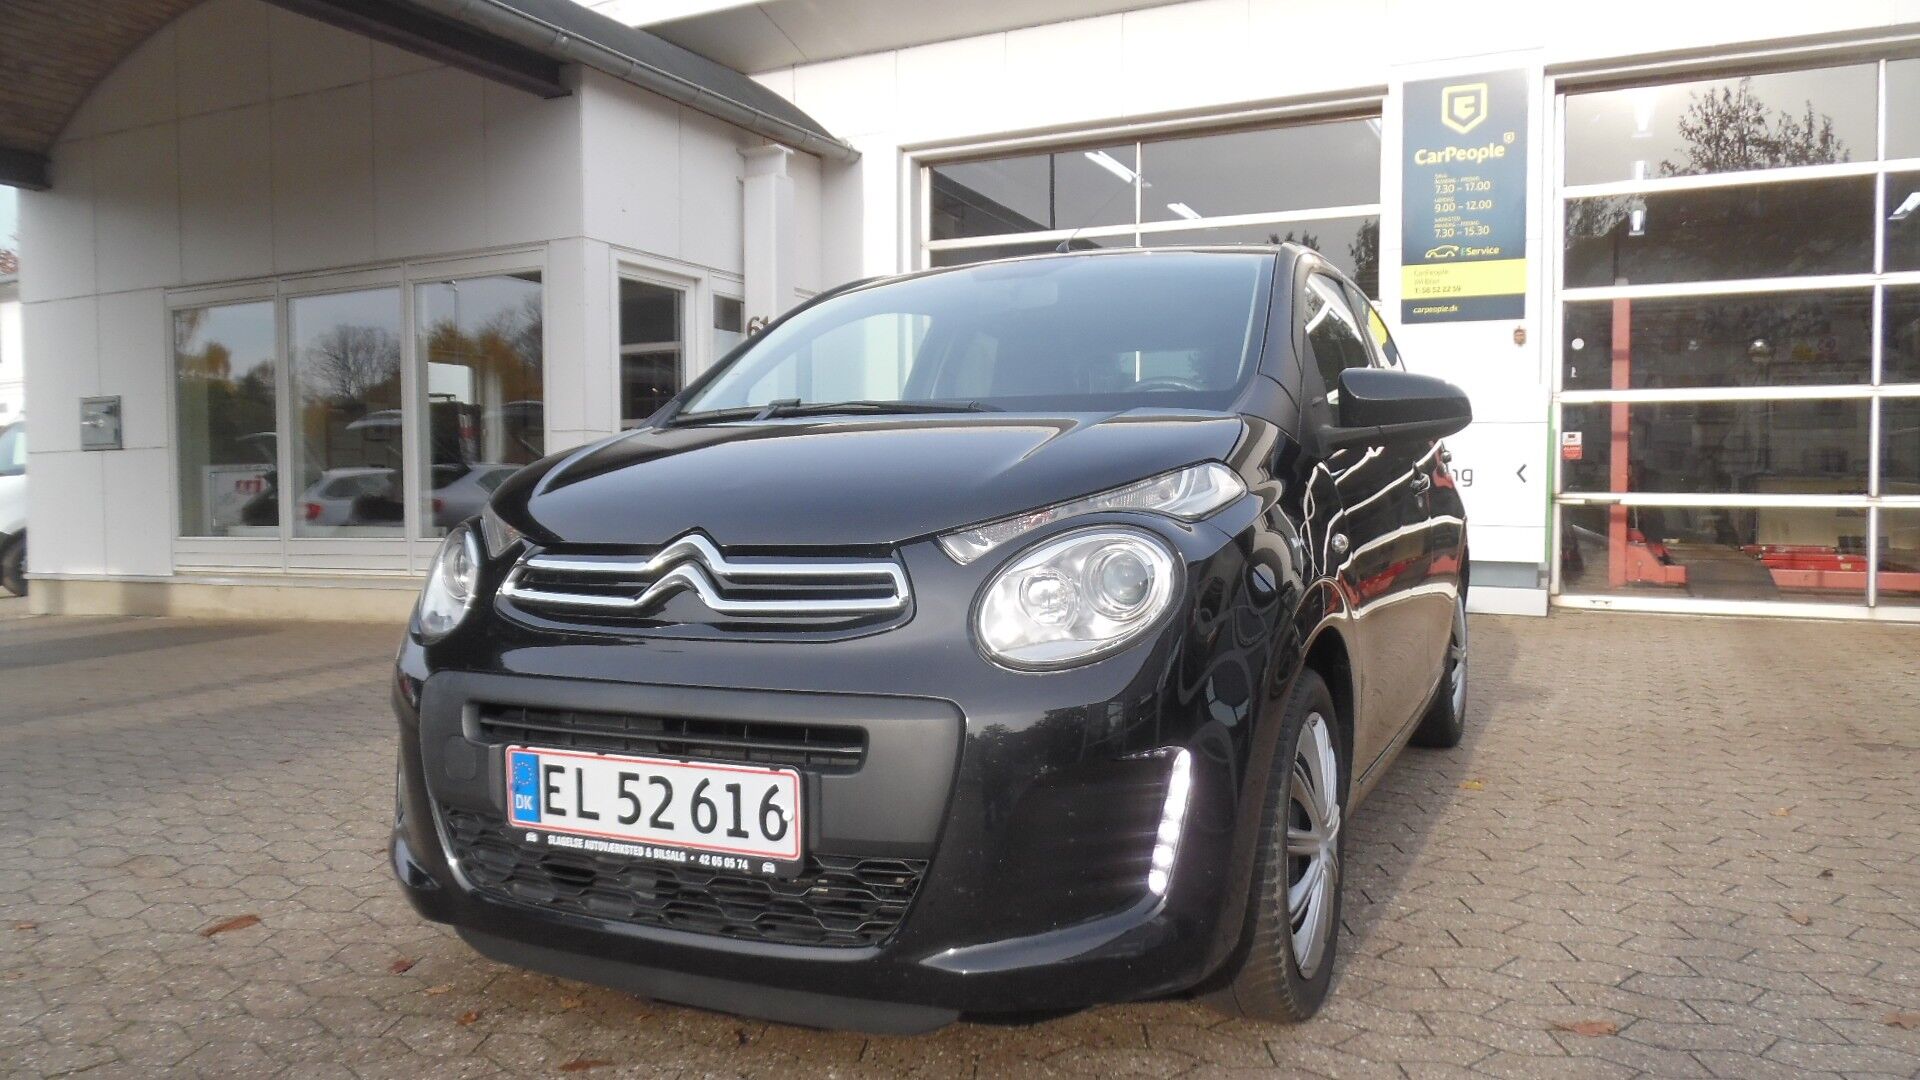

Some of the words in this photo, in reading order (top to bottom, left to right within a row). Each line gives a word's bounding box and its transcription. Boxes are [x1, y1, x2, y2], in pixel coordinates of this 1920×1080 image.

[1414, 142, 1505, 165] CarPeople
[1435, 183, 1455, 195] 7.30
[1465, 180, 1491, 191] 17.00
[1434, 202, 1456, 213] 9.00
[1466, 199, 1492, 210] 12.00
[1434, 228, 1455, 239] 7.30
[1465, 224, 1490, 236] 15.30
[515, 795, 533, 811] DK
[543, 764, 600, 821] EL
[617, 771, 675, 830] 52
[690, 777, 790, 842] 616
[547, 834, 584, 849] SLAGELSE
[653, 845, 686, 862] BILSALG
[699, 854, 711, 865] 42
[736, 859, 749, 870] 74
